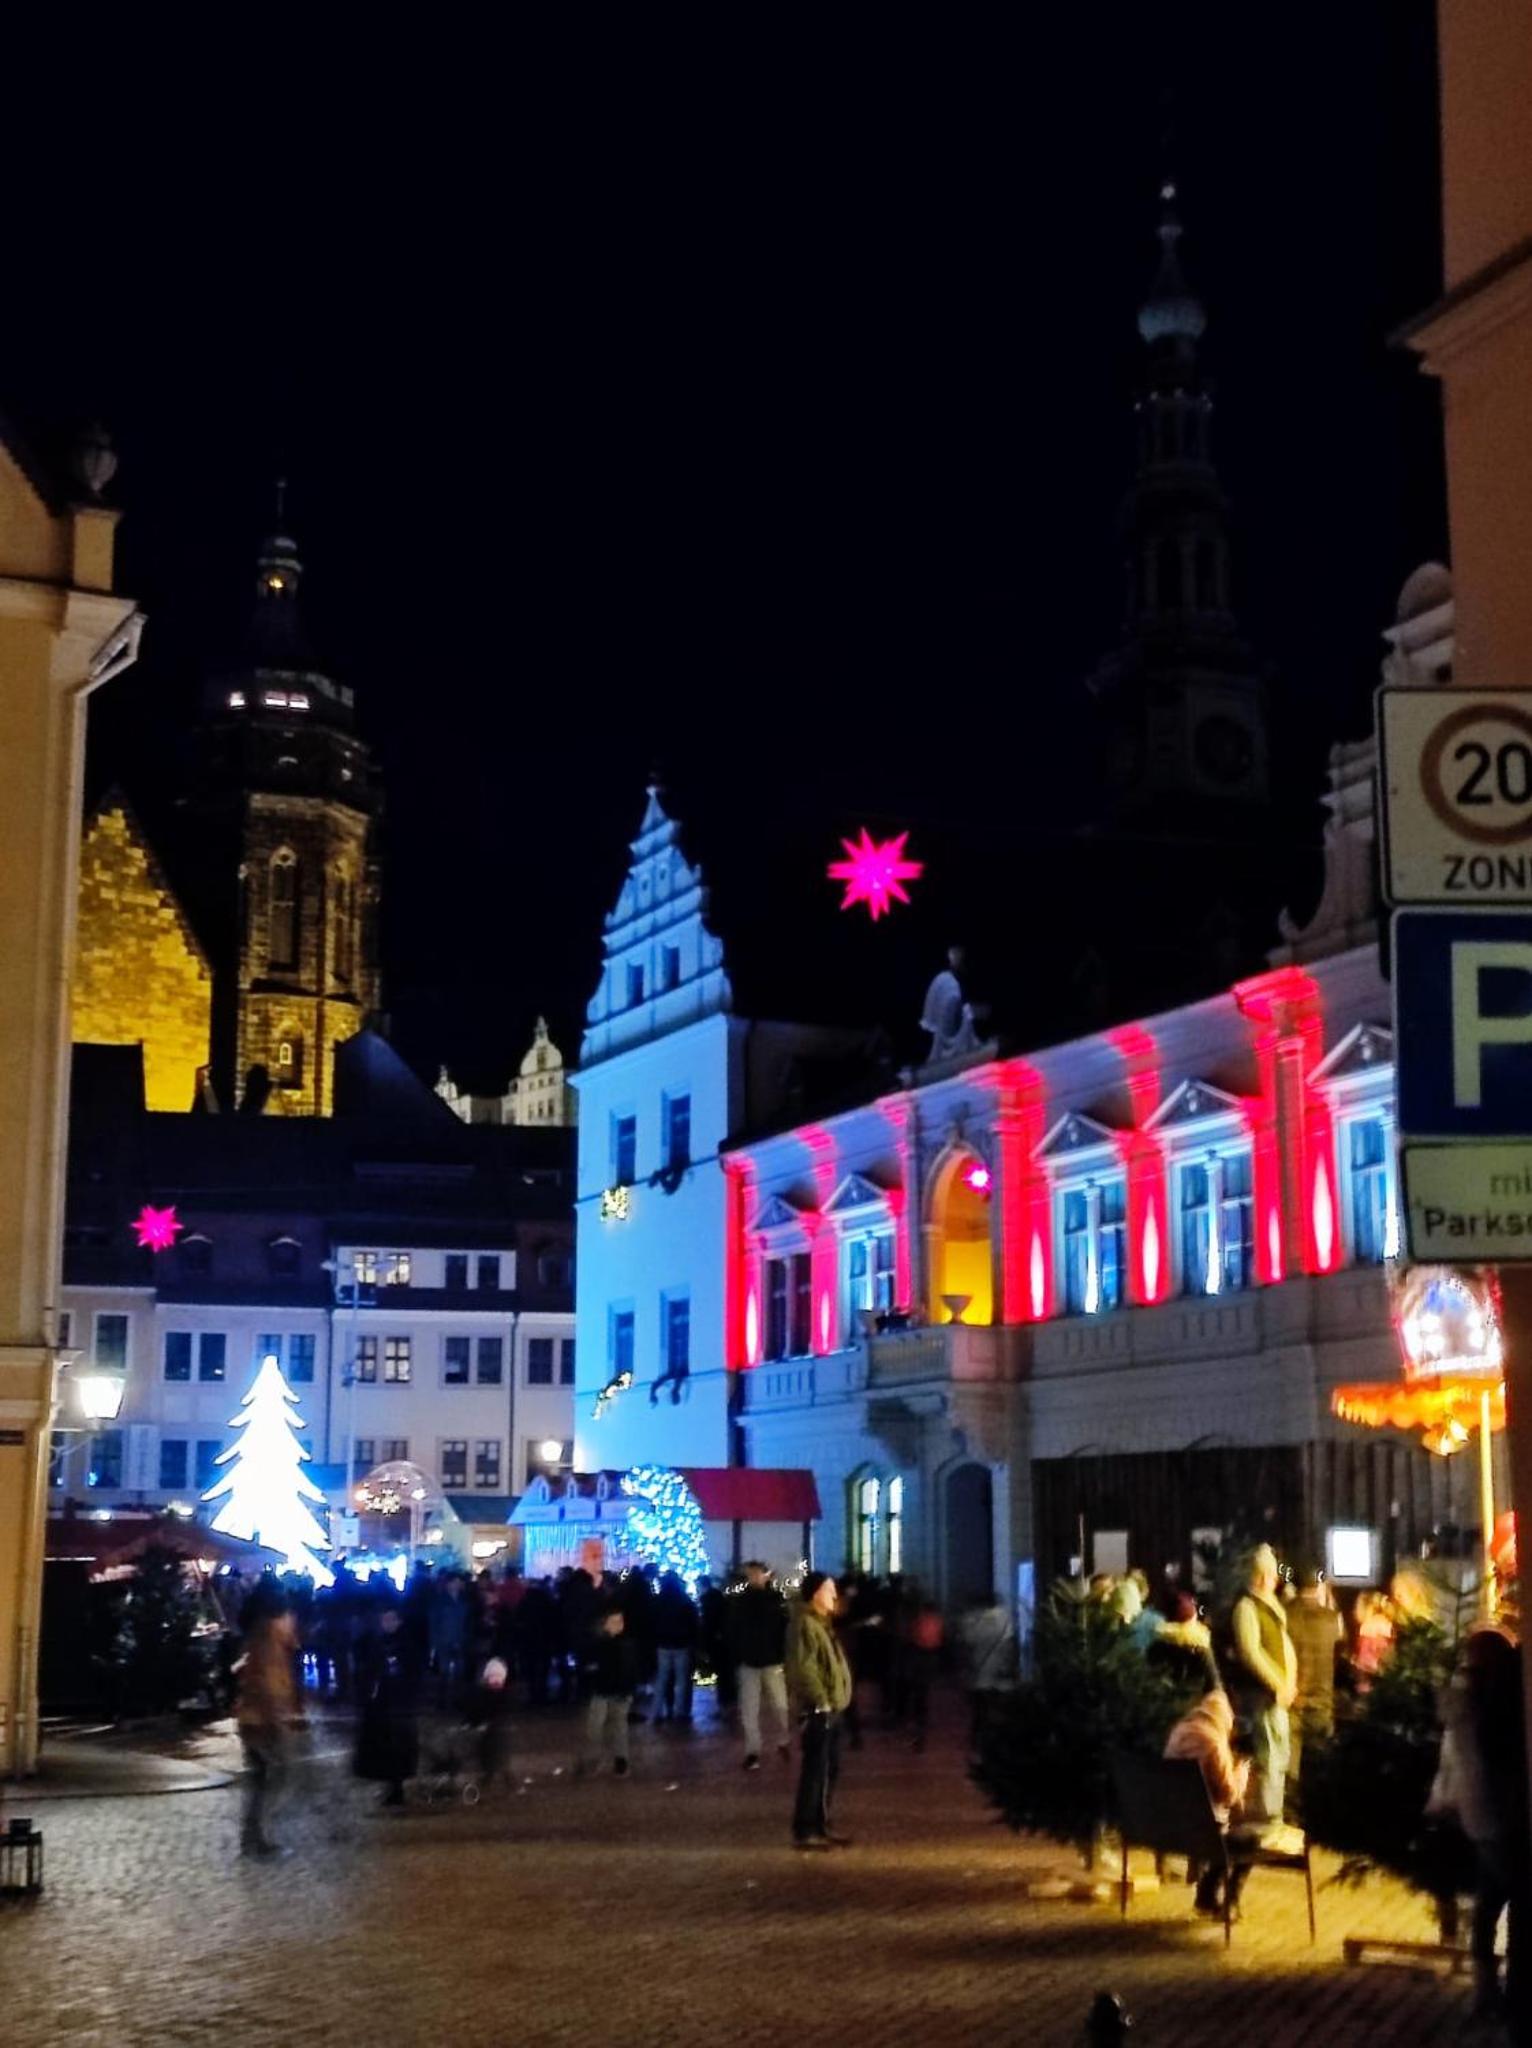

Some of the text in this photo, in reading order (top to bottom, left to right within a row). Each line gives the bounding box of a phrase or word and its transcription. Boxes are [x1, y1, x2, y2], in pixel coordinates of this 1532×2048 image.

[1454, 741, 1532, 805] 20
[1442, 854, 1532, 890] ZON
[1451, 941, 1532, 1108] P
